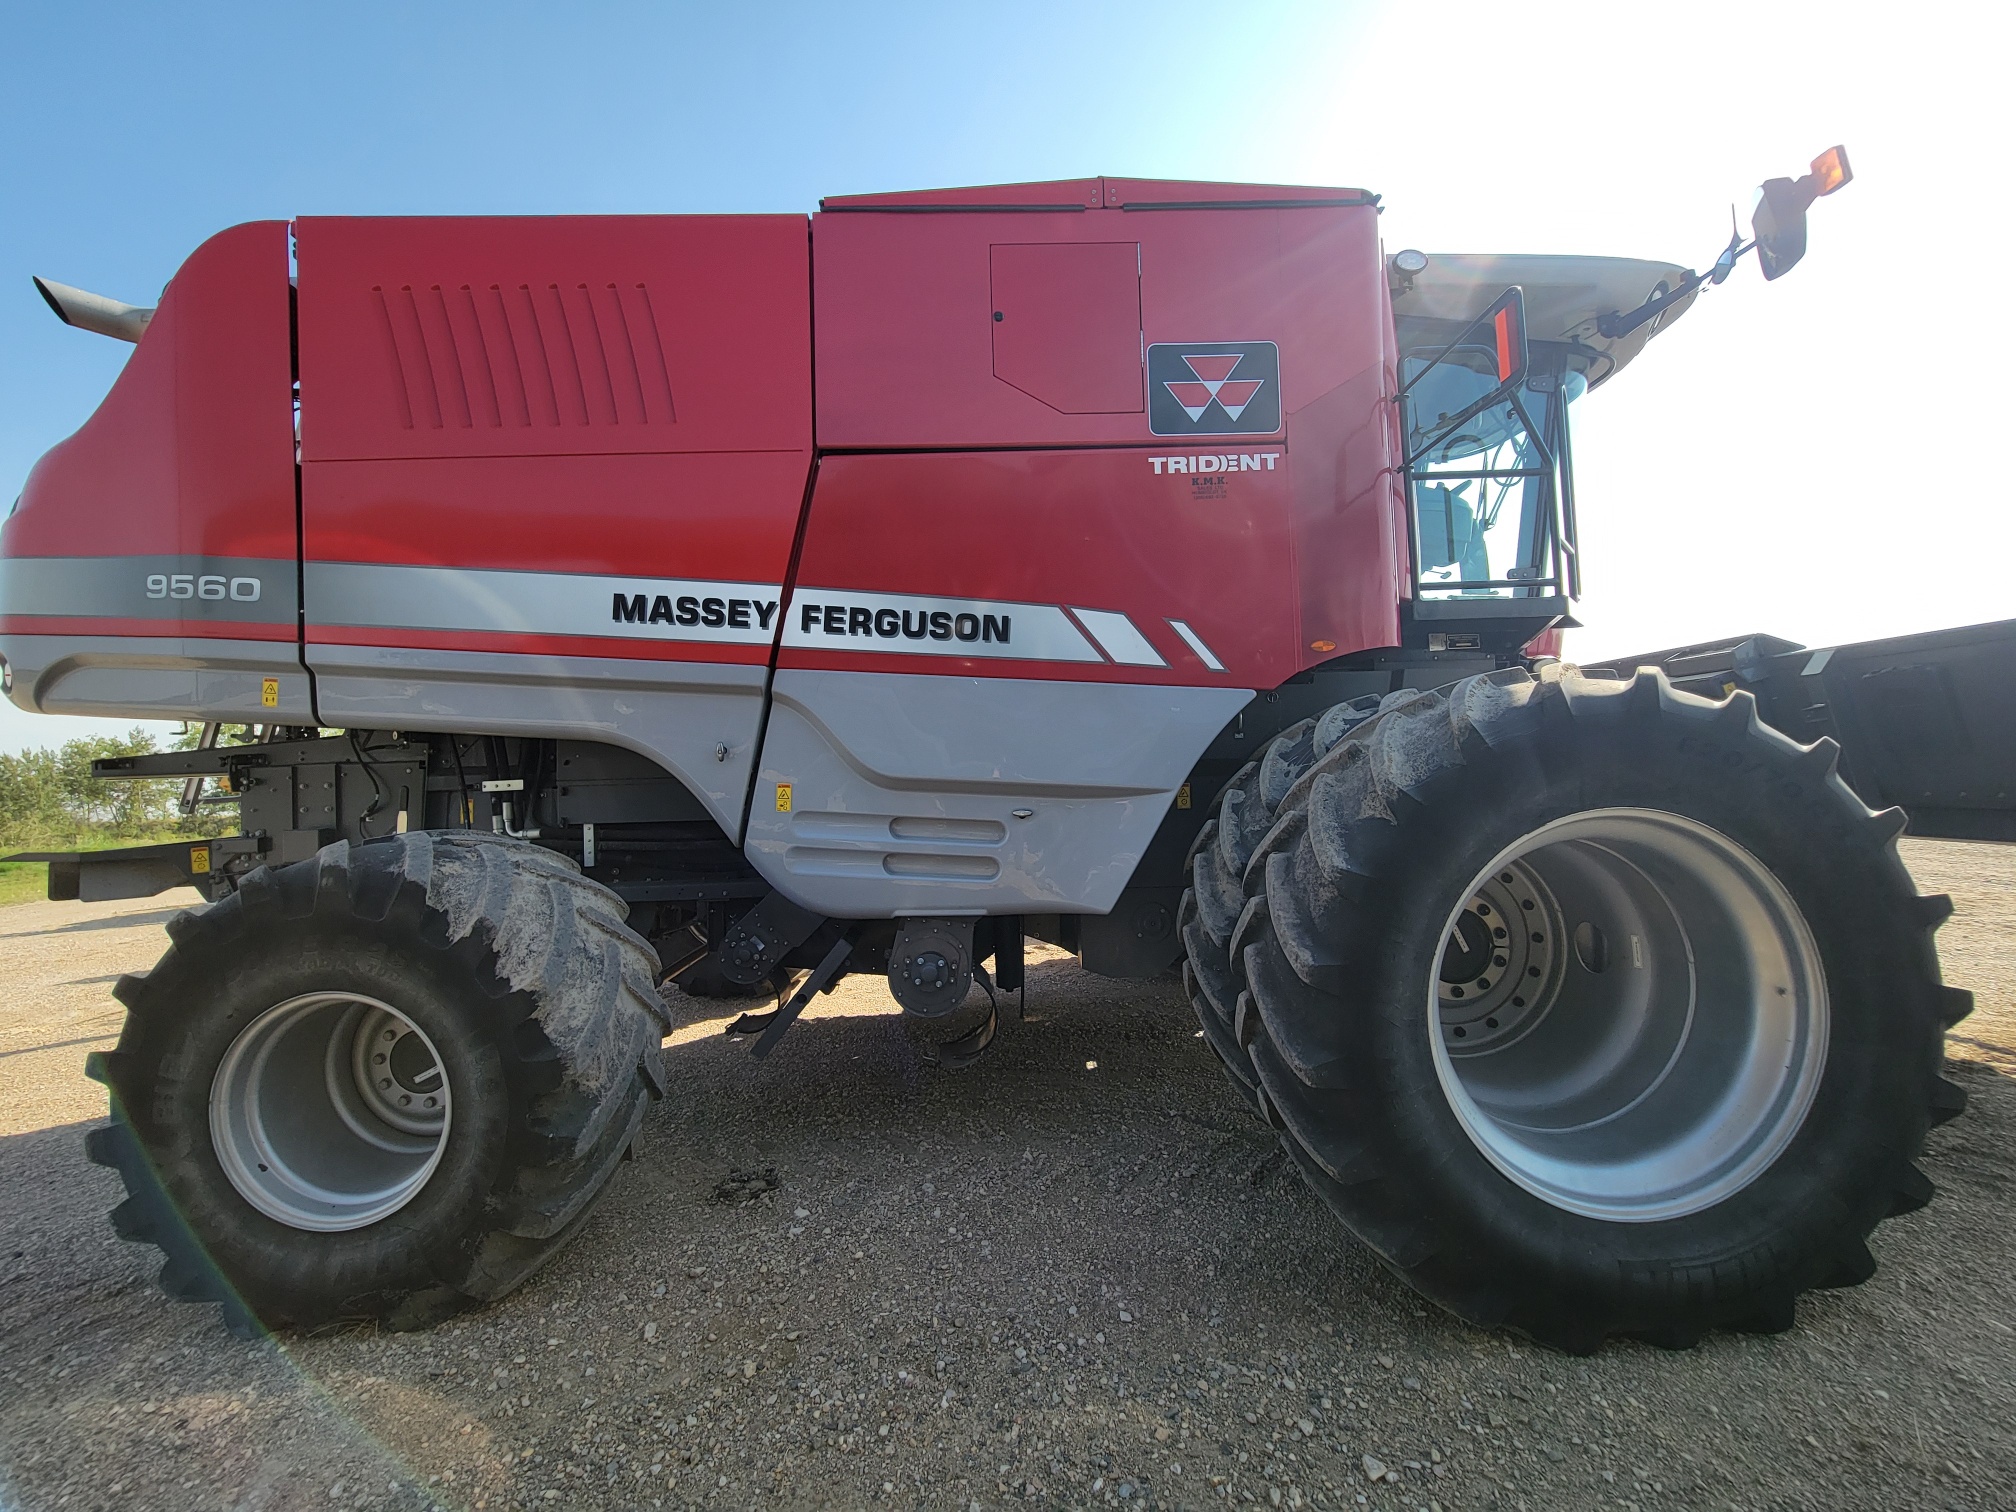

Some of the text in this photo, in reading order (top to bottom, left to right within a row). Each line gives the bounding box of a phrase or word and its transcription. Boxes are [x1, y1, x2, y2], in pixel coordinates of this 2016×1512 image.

[1148, 453, 1280, 474] TRIDENT
[1191, 476, 1229, 486] K.M.K.
[146, 574, 261, 602] 9560
[612, 593, 1010, 644] MASSEY FERGUSON
